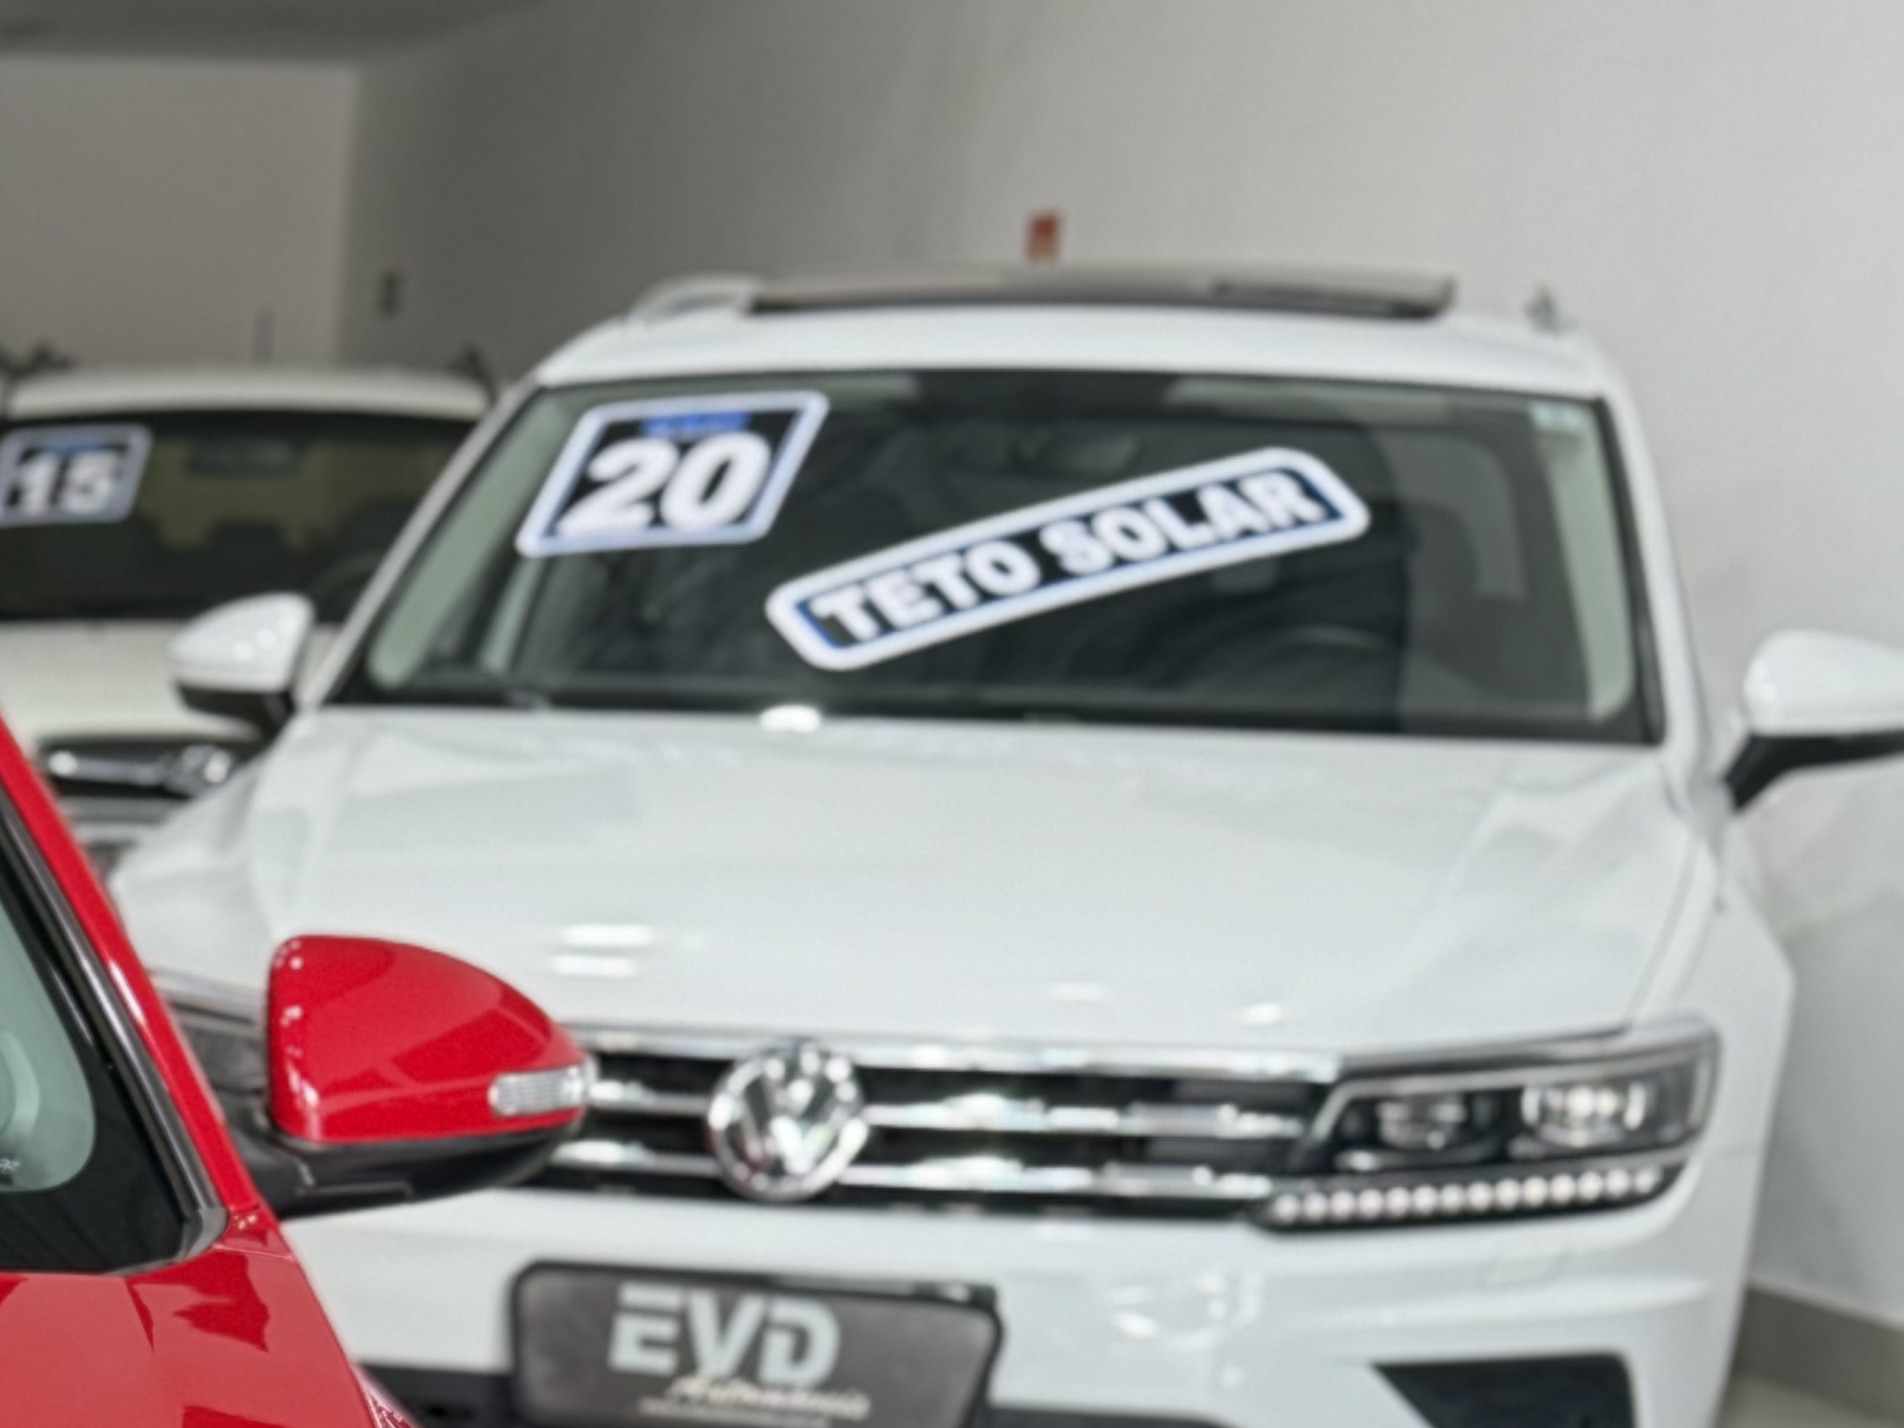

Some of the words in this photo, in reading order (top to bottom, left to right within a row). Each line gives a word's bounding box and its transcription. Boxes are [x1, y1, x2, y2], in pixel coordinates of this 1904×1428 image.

[16, 453, 120, 516] 15
[555, 431, 772, 536] 20
[808, 539, 1042, 642] TETO
[1040, 470, 1326, 577] SOLAR
[607, 1281, 841, 1388] EVD
